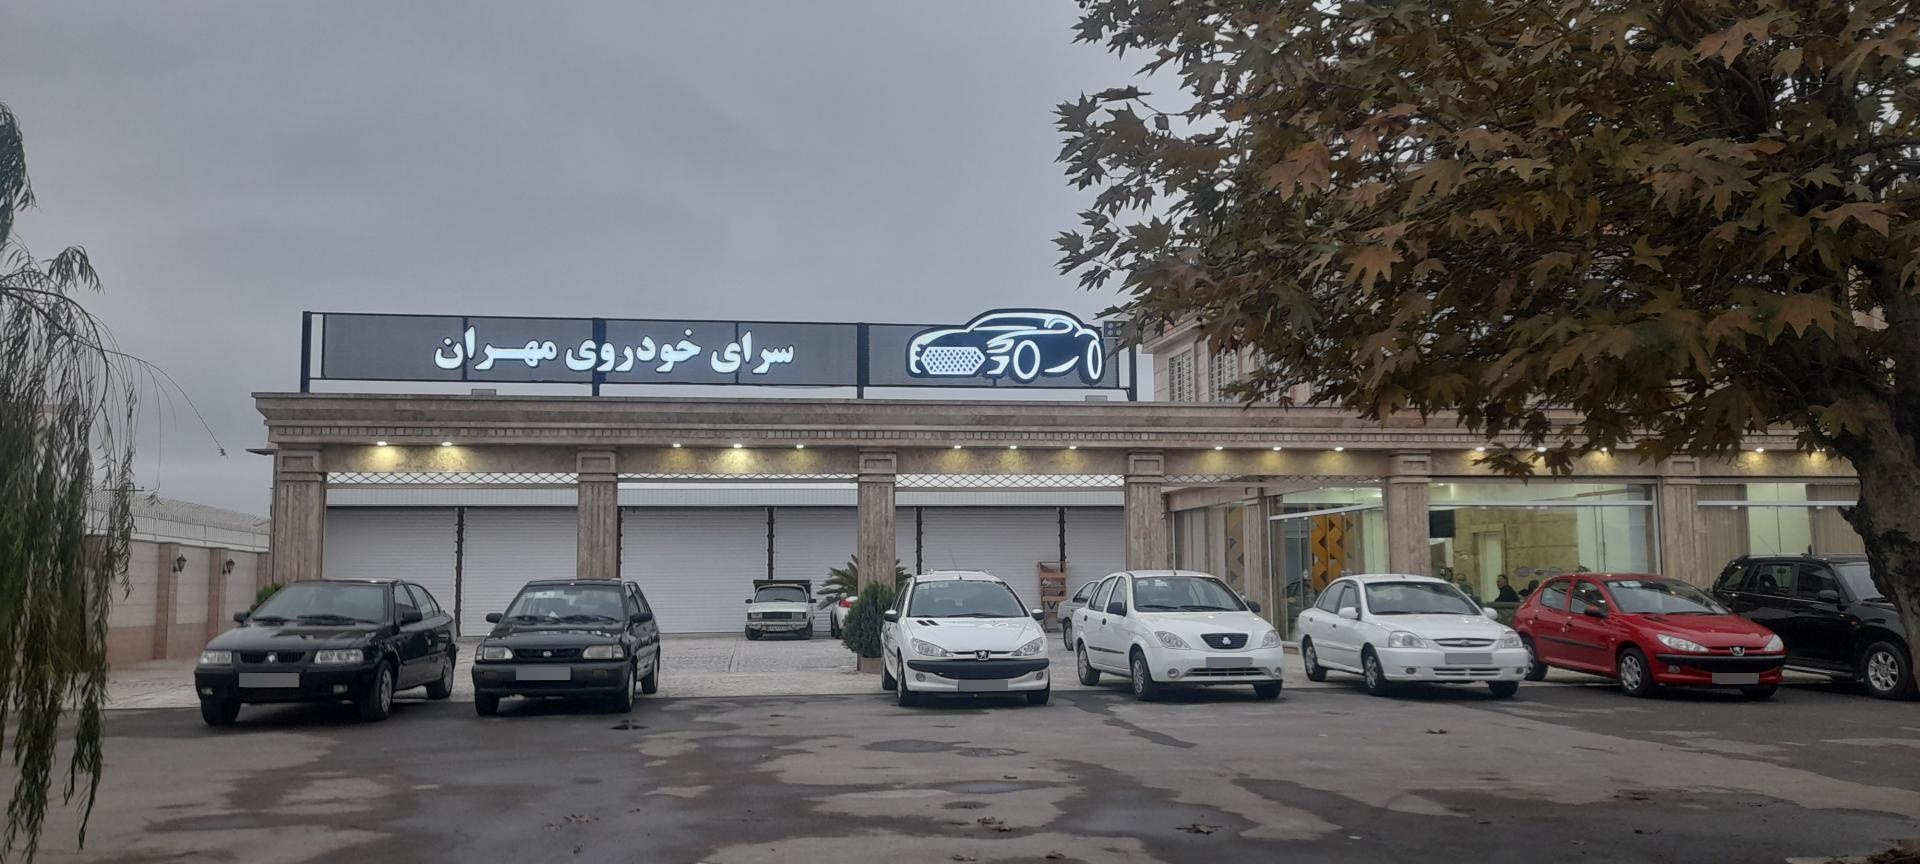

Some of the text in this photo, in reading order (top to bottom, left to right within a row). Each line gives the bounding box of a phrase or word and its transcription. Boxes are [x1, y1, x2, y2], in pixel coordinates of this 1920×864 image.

[434, 325, 795, 375] سرای خودروی مهران
